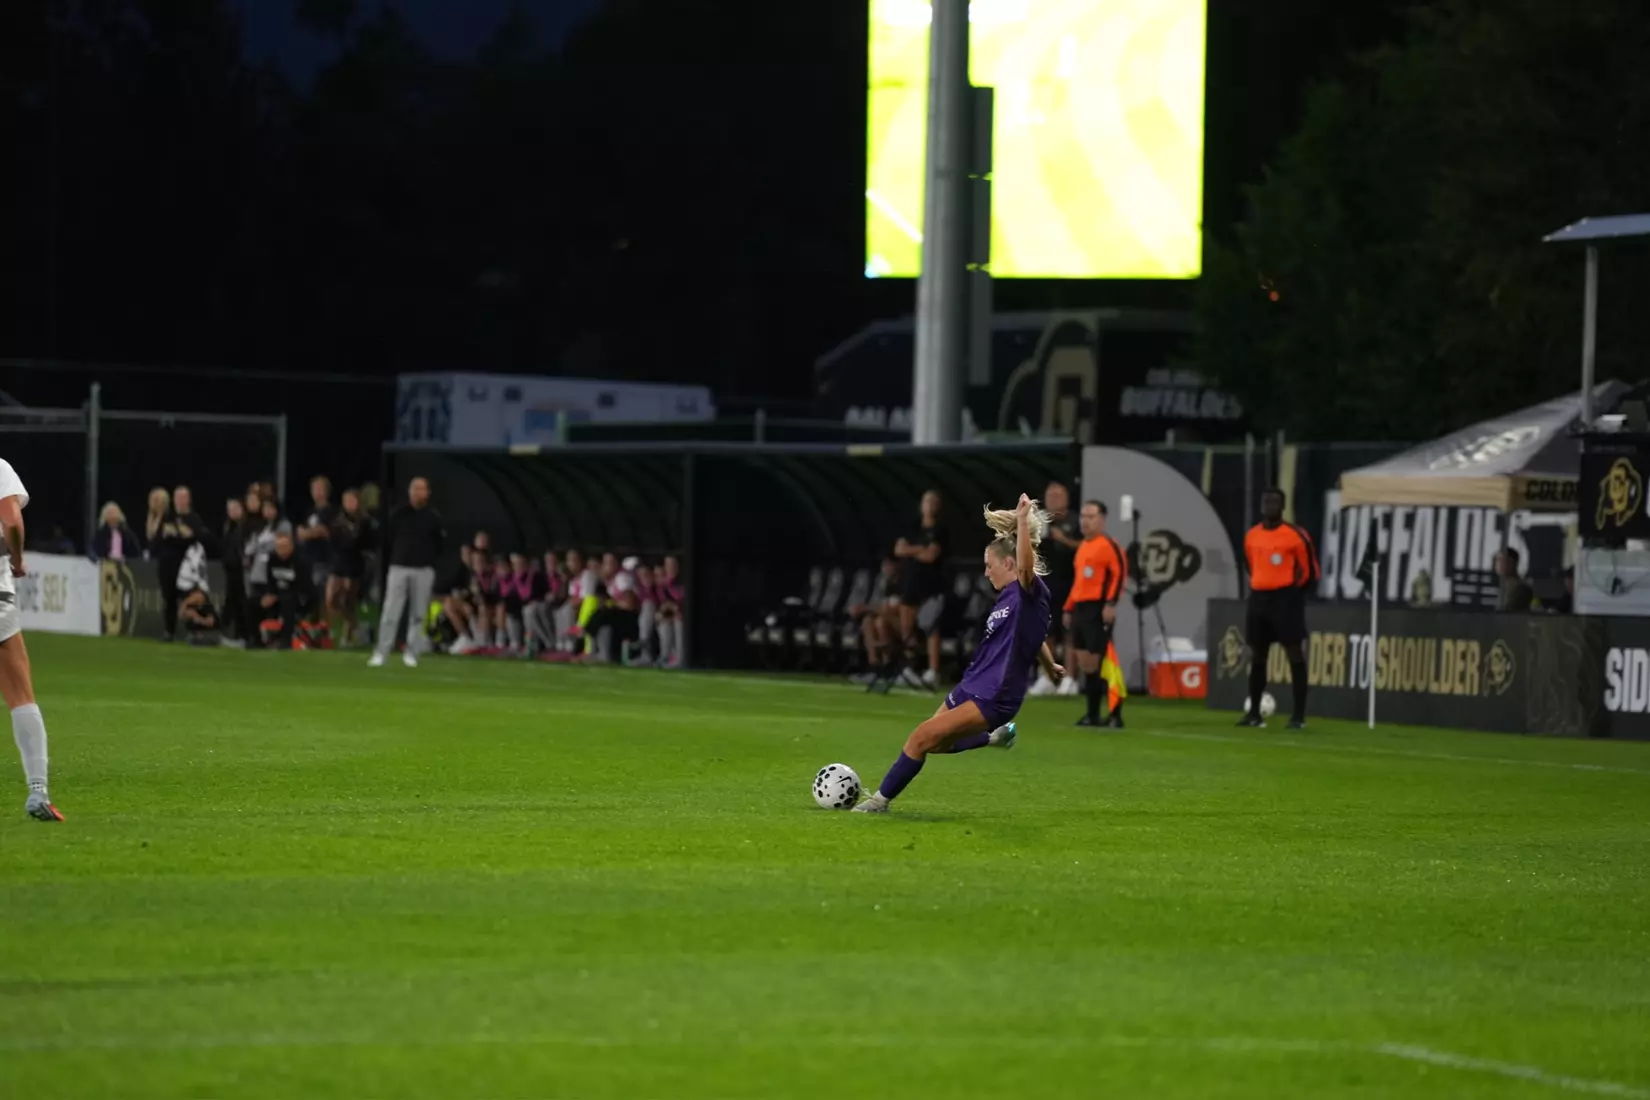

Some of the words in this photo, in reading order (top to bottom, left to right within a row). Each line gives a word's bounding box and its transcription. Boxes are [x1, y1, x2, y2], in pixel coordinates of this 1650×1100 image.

[1181, 666, 1201, 689] G
[1376, 635, 1481, 696] SHOULDER
[1604, 647, 1650, 714] SID
